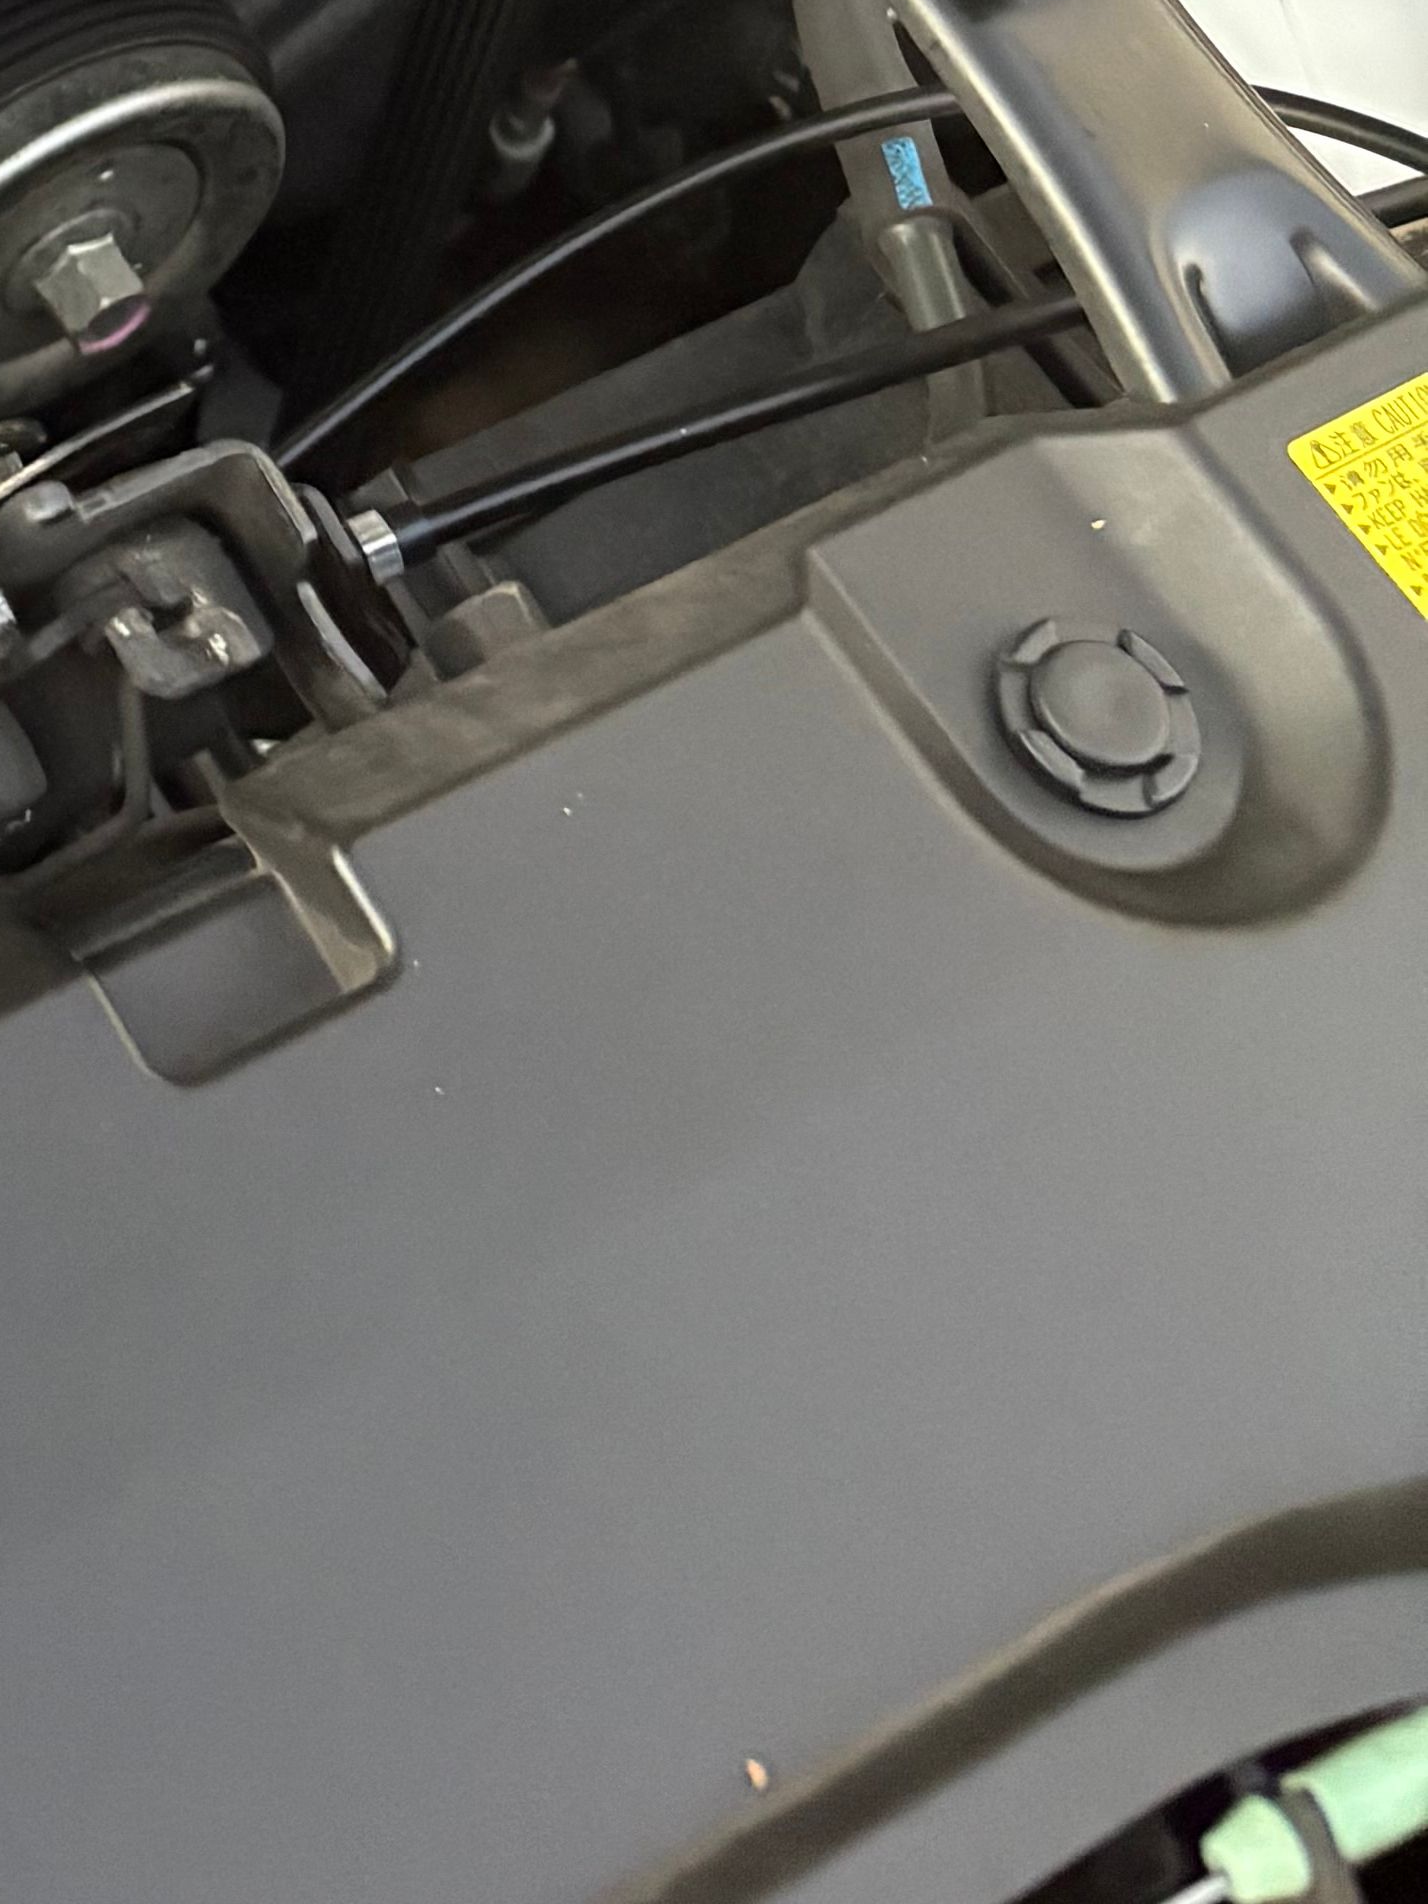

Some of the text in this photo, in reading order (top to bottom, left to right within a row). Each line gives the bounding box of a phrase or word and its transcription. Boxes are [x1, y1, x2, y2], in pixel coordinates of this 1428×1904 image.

[1372, 384, 1428, 434] CAUTIO
[1368, 498, 1407, 530] KEEP
[1383, 526, 1413, 552] LE
